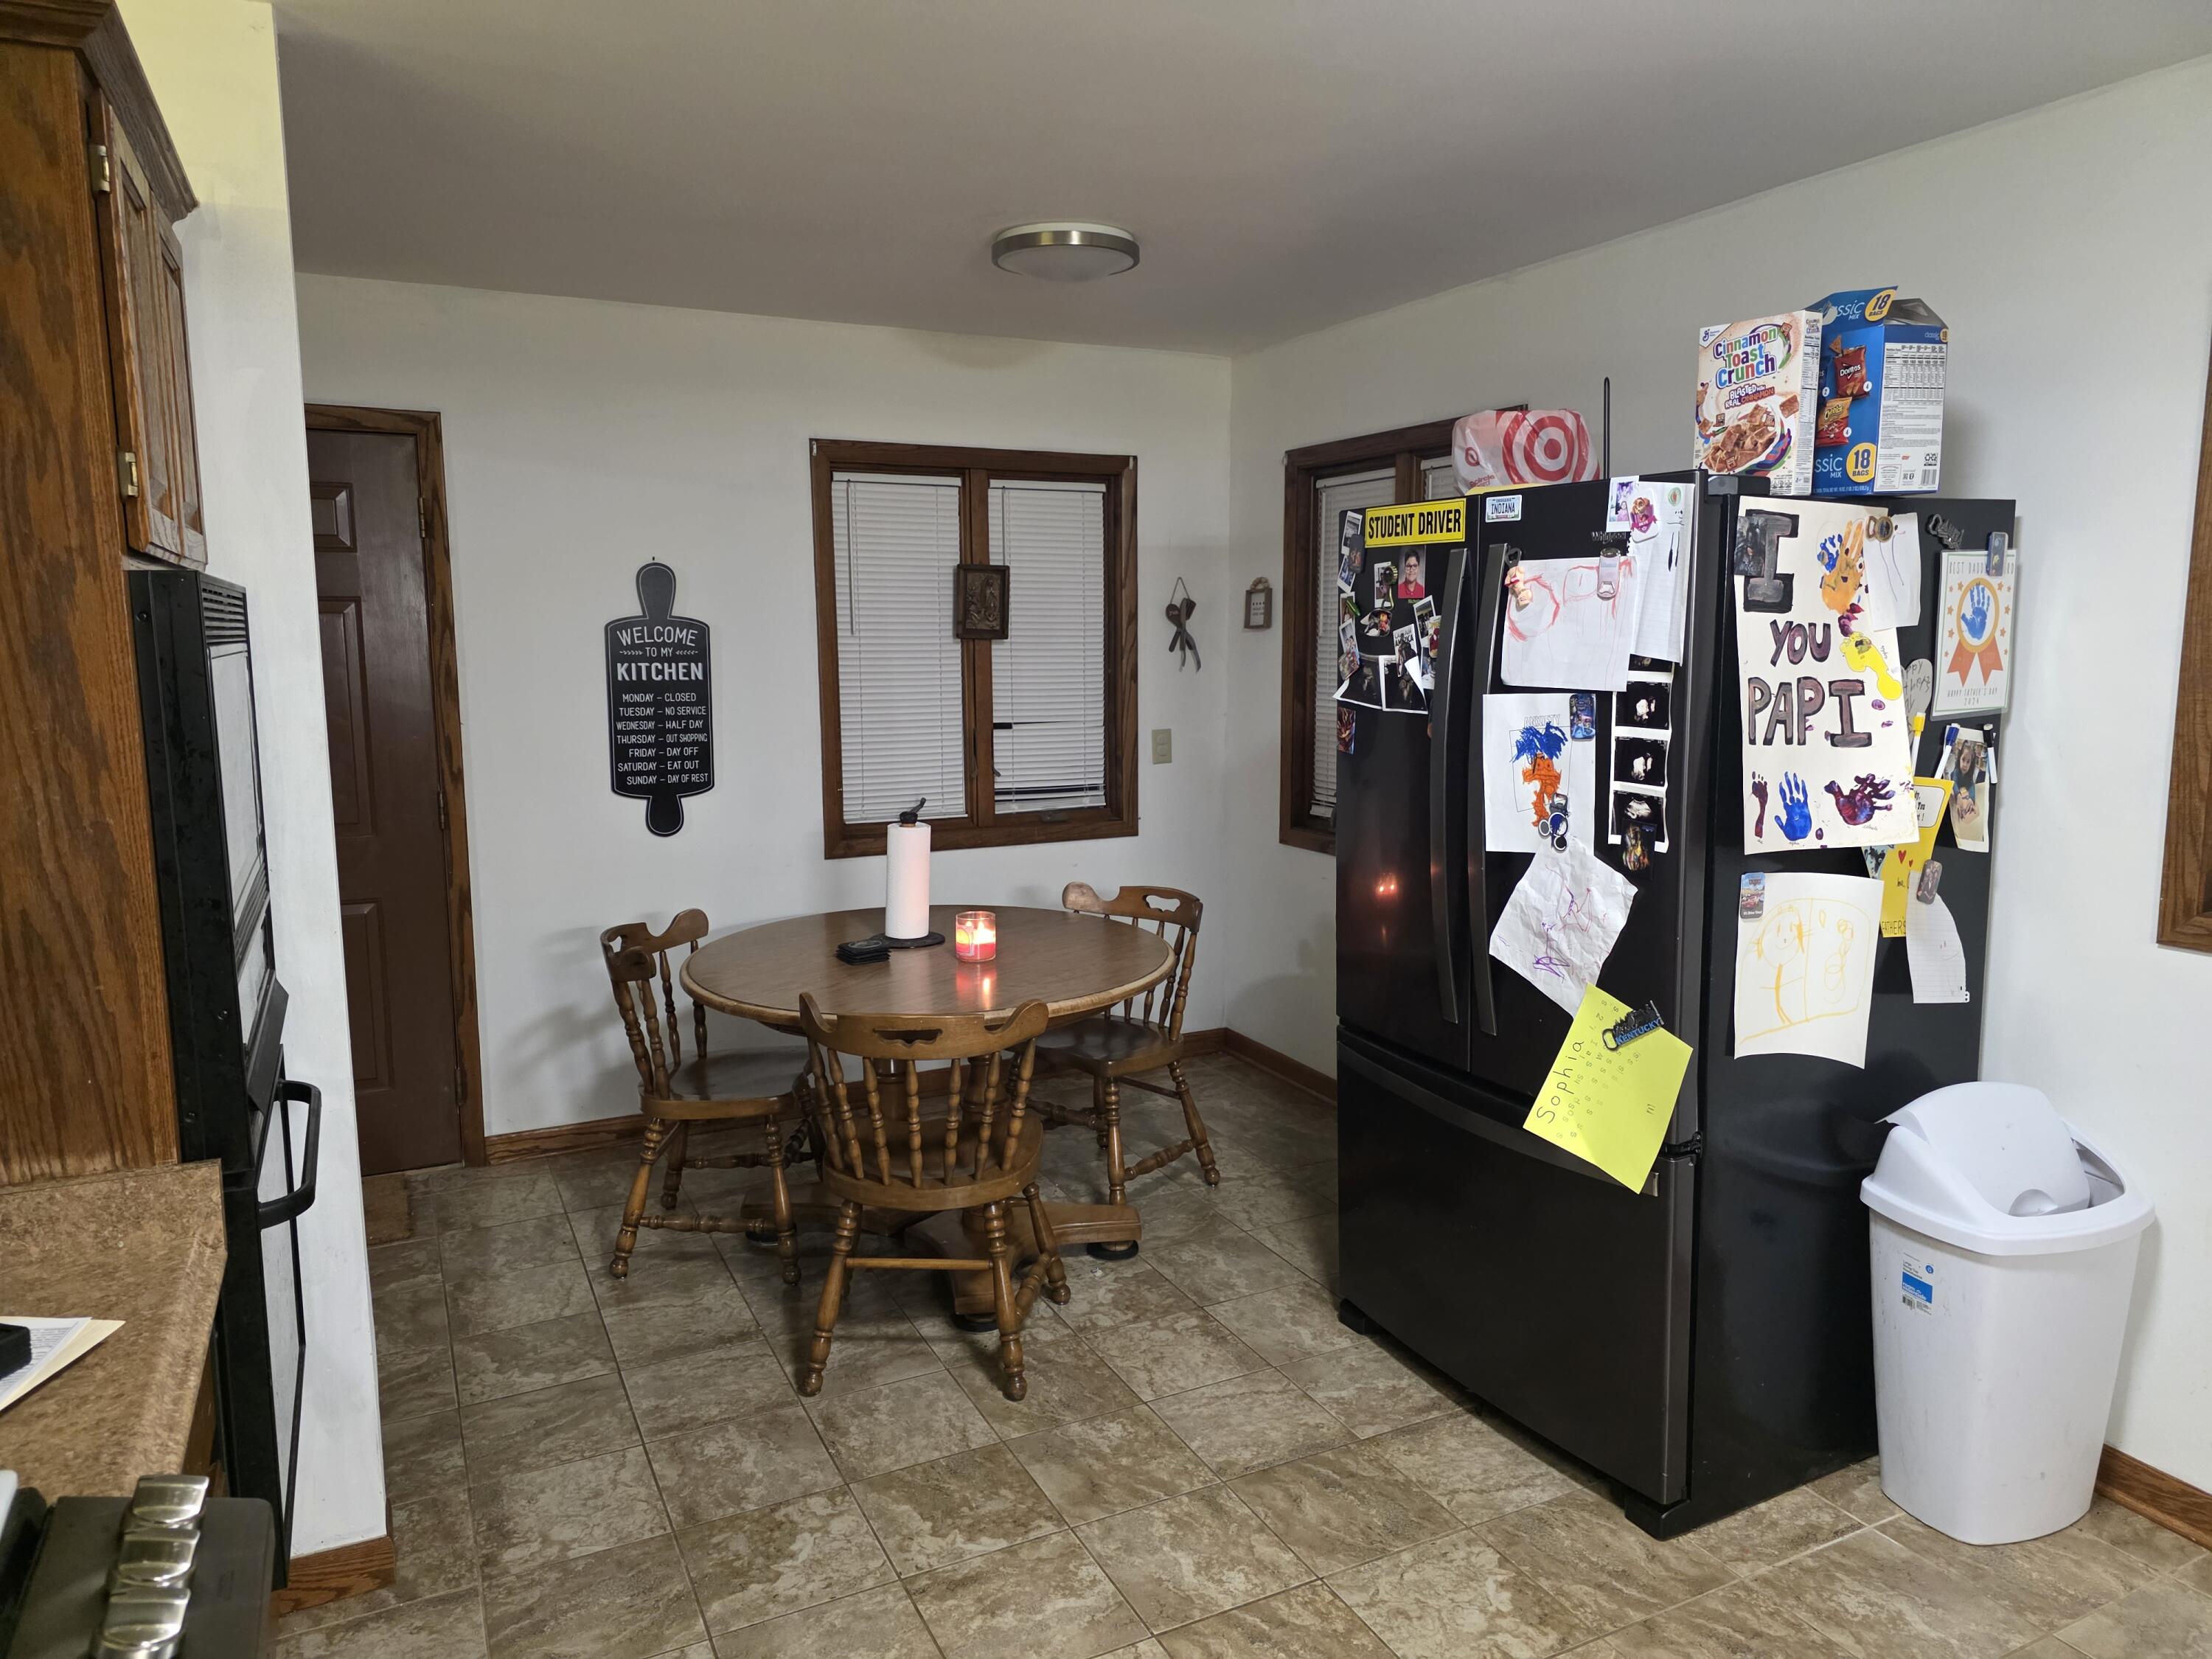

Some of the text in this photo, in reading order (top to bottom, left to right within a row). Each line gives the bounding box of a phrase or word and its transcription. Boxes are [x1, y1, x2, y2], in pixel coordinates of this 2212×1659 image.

[1834, 300, 1865, 317] ssic
[1872, 294, 1891, 310] 18
[1715, 327, 1777, 358] Cinnamon
[1725, 344, 1764, 369] Toast
[1717, 354, 1775, 388] Crunch
[1840, 364, 1861, 376] Doritos
[1725, 387, 1774, 408] REAL CINNAMON
[1730, 383, 1756, 400] BLASTED
[1823, 404, 1844, 420] Cheetos
[1814, 453, 1843, 473] ssic
[1854, 448, 1871, 470] 18
[1491, 502, 1515, 515] INDIANA
[1368, 508, 1461, 540] STUDENT DRIVER
[1949, 561, 1984, 574] BEST DADD
[616, 626, 698, 646] WELCOME
[1770, 619, 1831, 667] YOU
[645, 647, 673, 657] TO MY
[616, 662, 704, 681] KITCHEN
[622, 693, 654, 702] MONDAY
[664, 693, 697, 701] CLOSED
[619, 707, 655, 716] TUESDAY
[665, 707, 675, 715] NO
[677, 706, 706, 715] SERVICE
[1747, 676, 1872, 748] PAPI
[616, 721, 655, 730] WEDNESDAY
[666, 720, 686, 728] HALF
[689, 720, 703, 728] DAY
[616, 734, 655, 744] THURSDAY
[666, 734, 678, 742] OUT
[679, 734, 708, 742] SHOPPING
[629, 748, 656, 757] FRIDAY
[667, 748, 681, 756] DAY
[684, 747, 699, 756] OFF
[618, 762, 657, 771] SATURDAY
[667, 761, 682, 770] EAT
[684, 760, 700, 769] OUT
[627, 775, 657, 785] SUNDAY
[667, 774, 679, 783] DAY
[681, 774, 689, 782] OF
[692, 773, 709, 782] REST
[1615, 1018, 1661, 1046] KENTUCKY
[1536, 1040, 1585, 1124] Sophia
